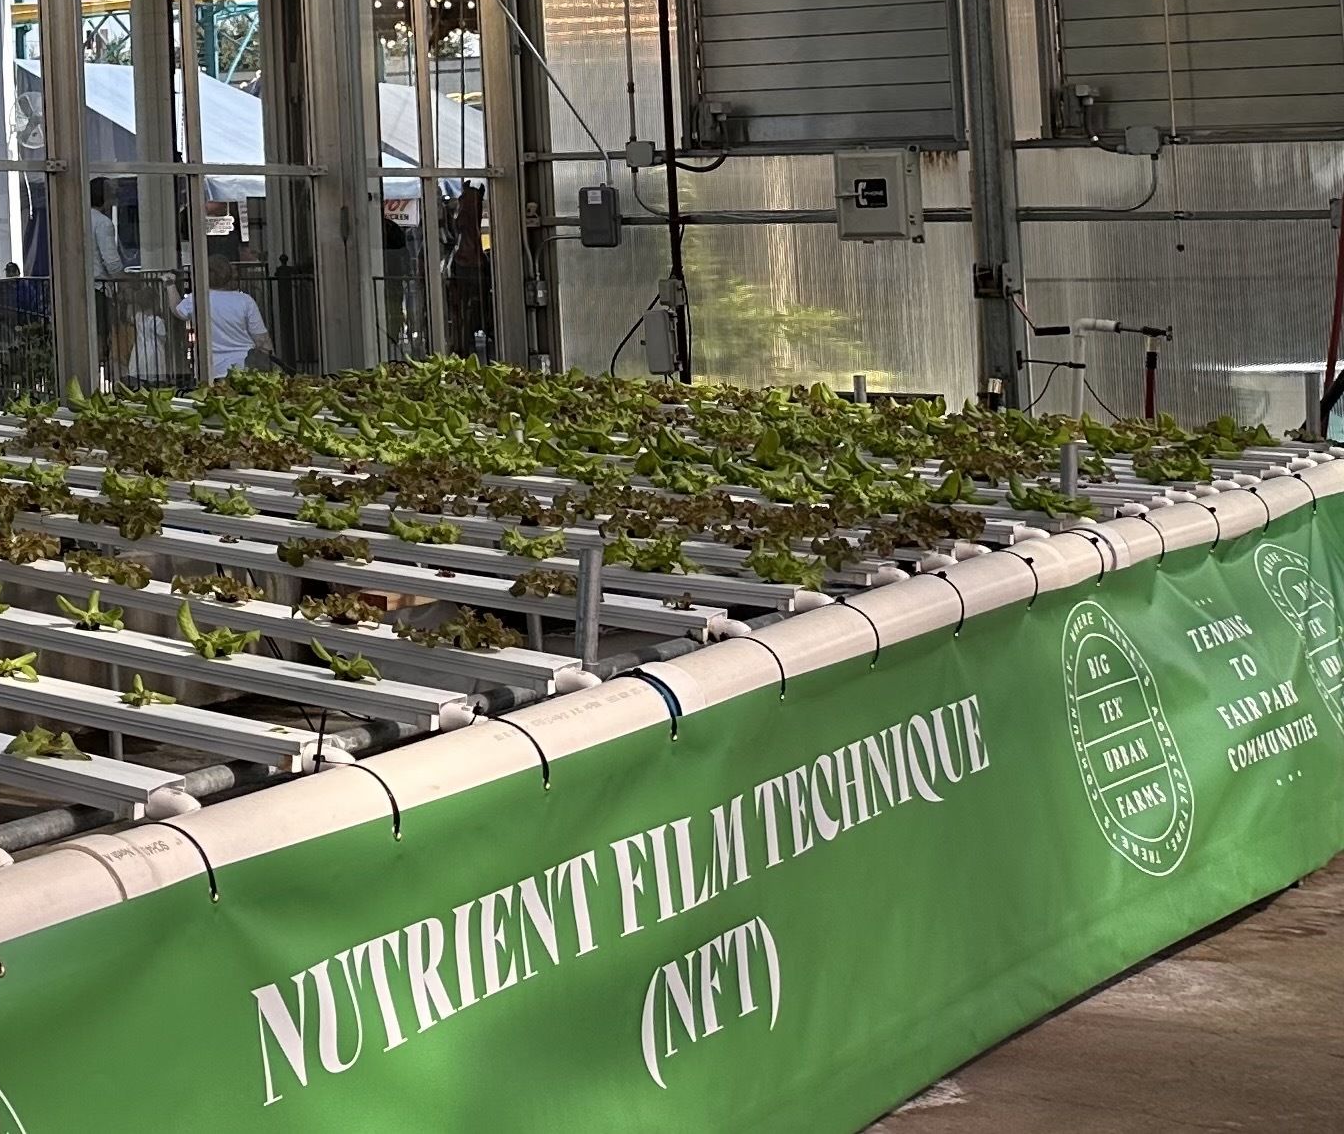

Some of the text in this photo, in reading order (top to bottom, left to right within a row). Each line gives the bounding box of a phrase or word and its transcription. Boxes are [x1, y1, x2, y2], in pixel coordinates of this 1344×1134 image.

[1186, 615, 1253, 653] TENDING
[1086, 653, 1111, 679] BIG
[1229, 654, 1258, 681] TO
[1099, 696, 1124, 724] TEX
[1217, 680, 1299, 730] FAIR PARK
[1102, 738, 1149, 773] URBAN
[1227, 713, 1318, 772] COMMUNITIES
[1115, 782, 1167, 819] FARMS
[250, 693, 991, 1108] NUTRIENT FILM TECHNIQUE
[641, 915, 782, 1090] (NFT)
